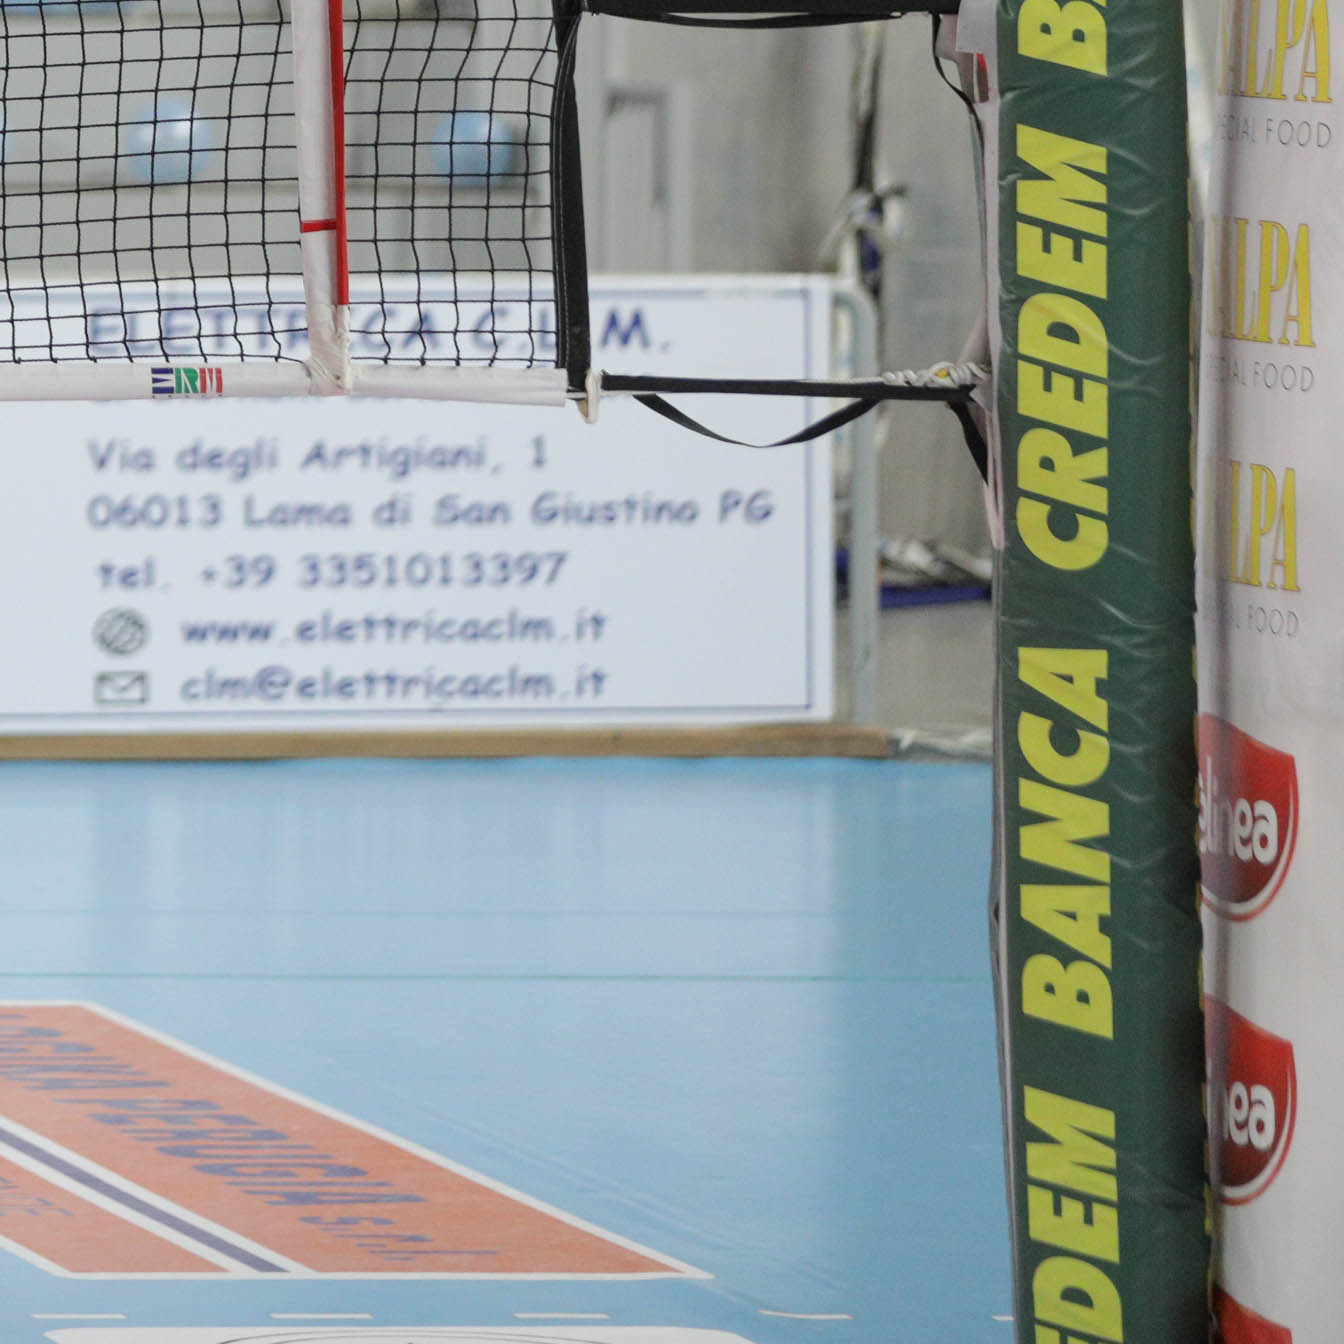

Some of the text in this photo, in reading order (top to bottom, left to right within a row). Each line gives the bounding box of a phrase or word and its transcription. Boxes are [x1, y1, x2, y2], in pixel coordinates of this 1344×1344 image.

[1265, 120, 1332, 149] FOOD
[1015, 122, 1110, 572] CREDEM
[1252, 362, 1315, 394] FOOD
[88, 437, 548, 481] Via degli Artigiani, 1
[86, 489, 775, 530] 06013 Lama di San Giustino PG
[100, 552, 569, 590] tel. +39 3351013397
[182, 609, 611, 644] www.elettricaclm.it
[1248, 606, 1299, 639] FOOD
[180, 667, 609, 704] clm@elettricaclm.it
[1017, 646, 1114, 1041] BANCA
[53, 1098, 429, 1207] PERUGIA
